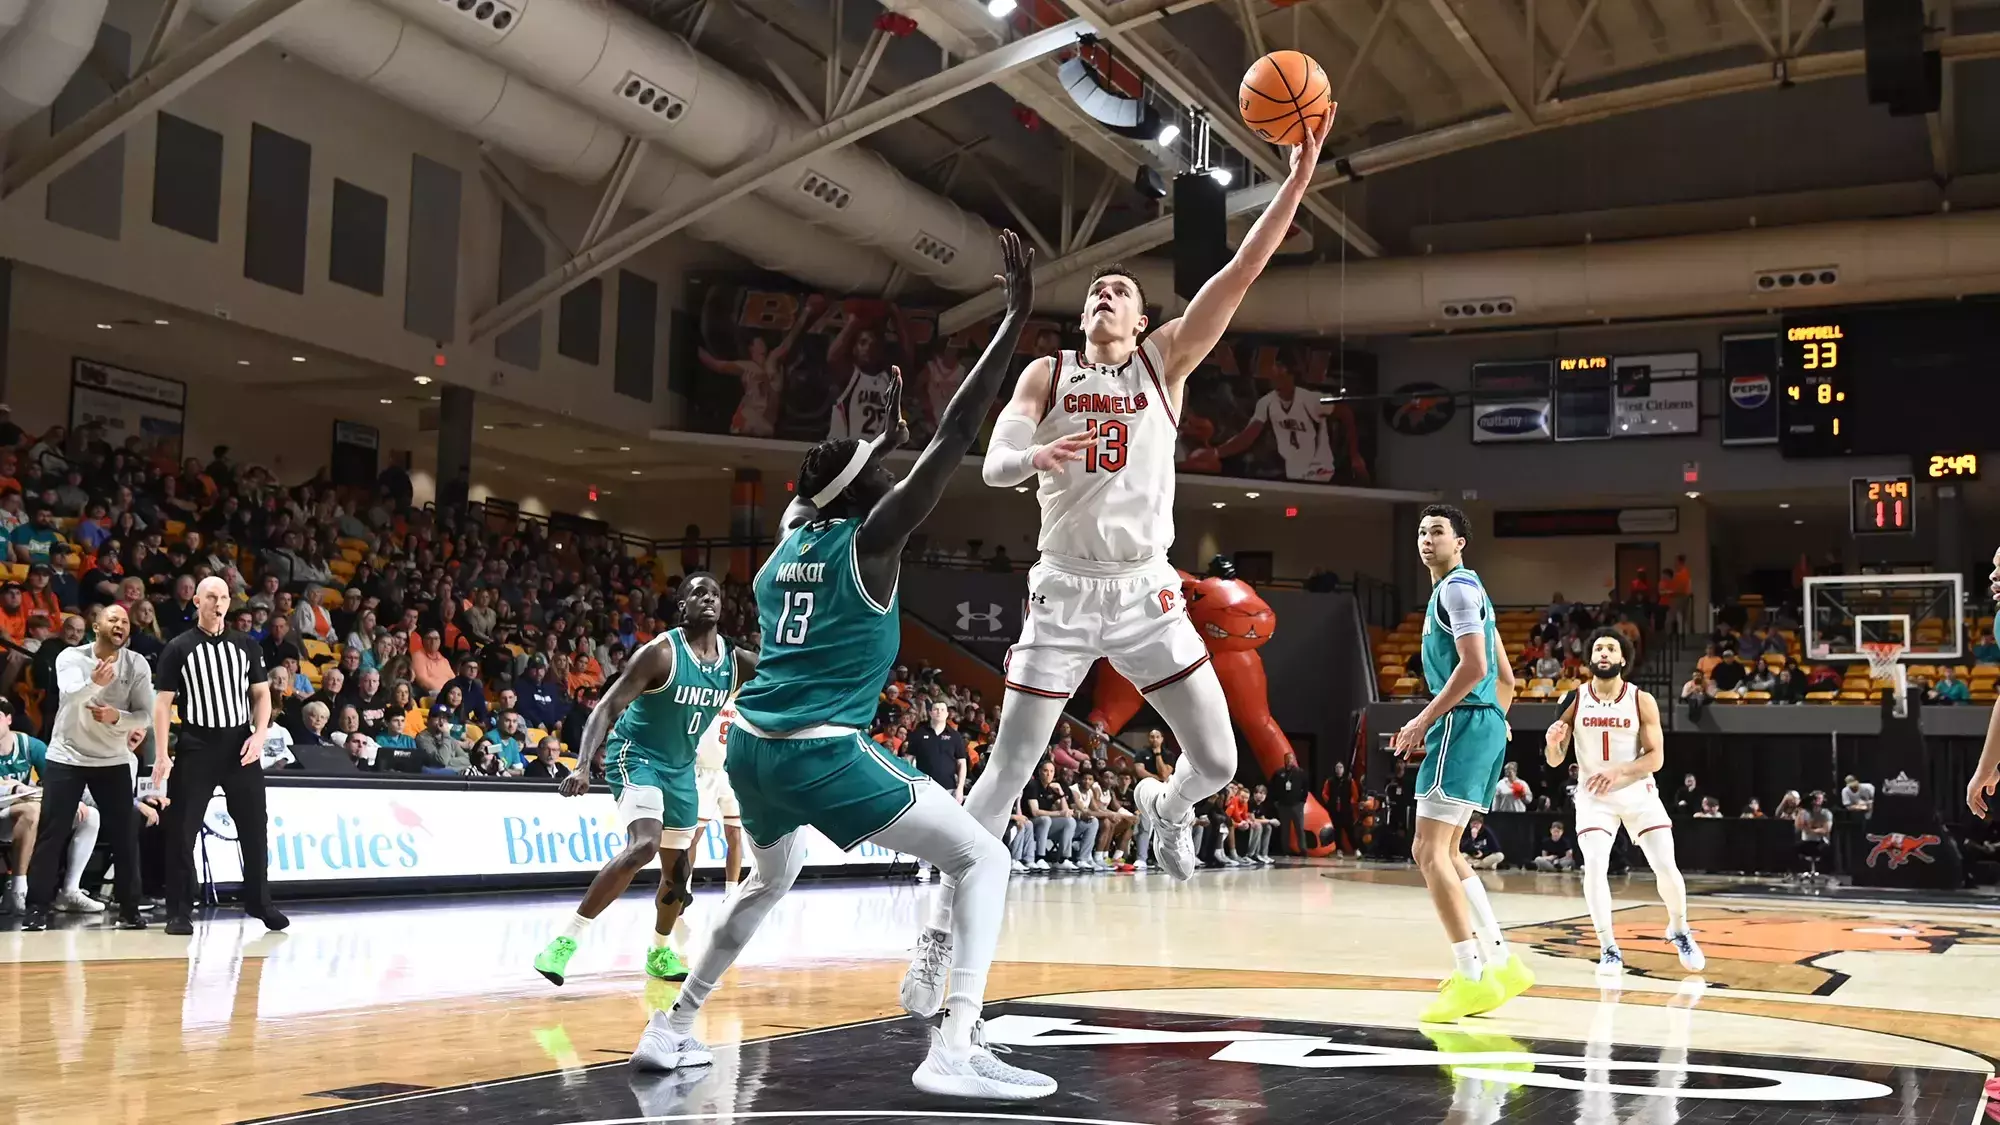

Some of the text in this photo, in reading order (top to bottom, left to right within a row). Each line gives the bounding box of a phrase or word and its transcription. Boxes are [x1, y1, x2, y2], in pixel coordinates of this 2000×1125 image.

[1788, 325, 1843, 341] CAMPBELL
[1803, 342, 1837, 369] 33
[1070, 374, 1086, 384] CAA
[1064, 392, 1149, 414] CAMELS
[1788, 385, 1800, 400] 4
[1645, 399, 1694, 411] Citizens
[1832, 417, 1840, 436] 1
[1085, 418, 1128, 473] 13
[1929, 454, 1976, 477] 2:49
[1875, 500, 1904, 527] 11
[775, 591, 814, 645] 13
[674, 685, 728, 707] UNCW
[1582, 716, 1631, 728] CAMELS
[1602, 731, 1610, 761] 1
[267, 813, 419, 870] irdies
[503, 815, 630, 865] Birdie
